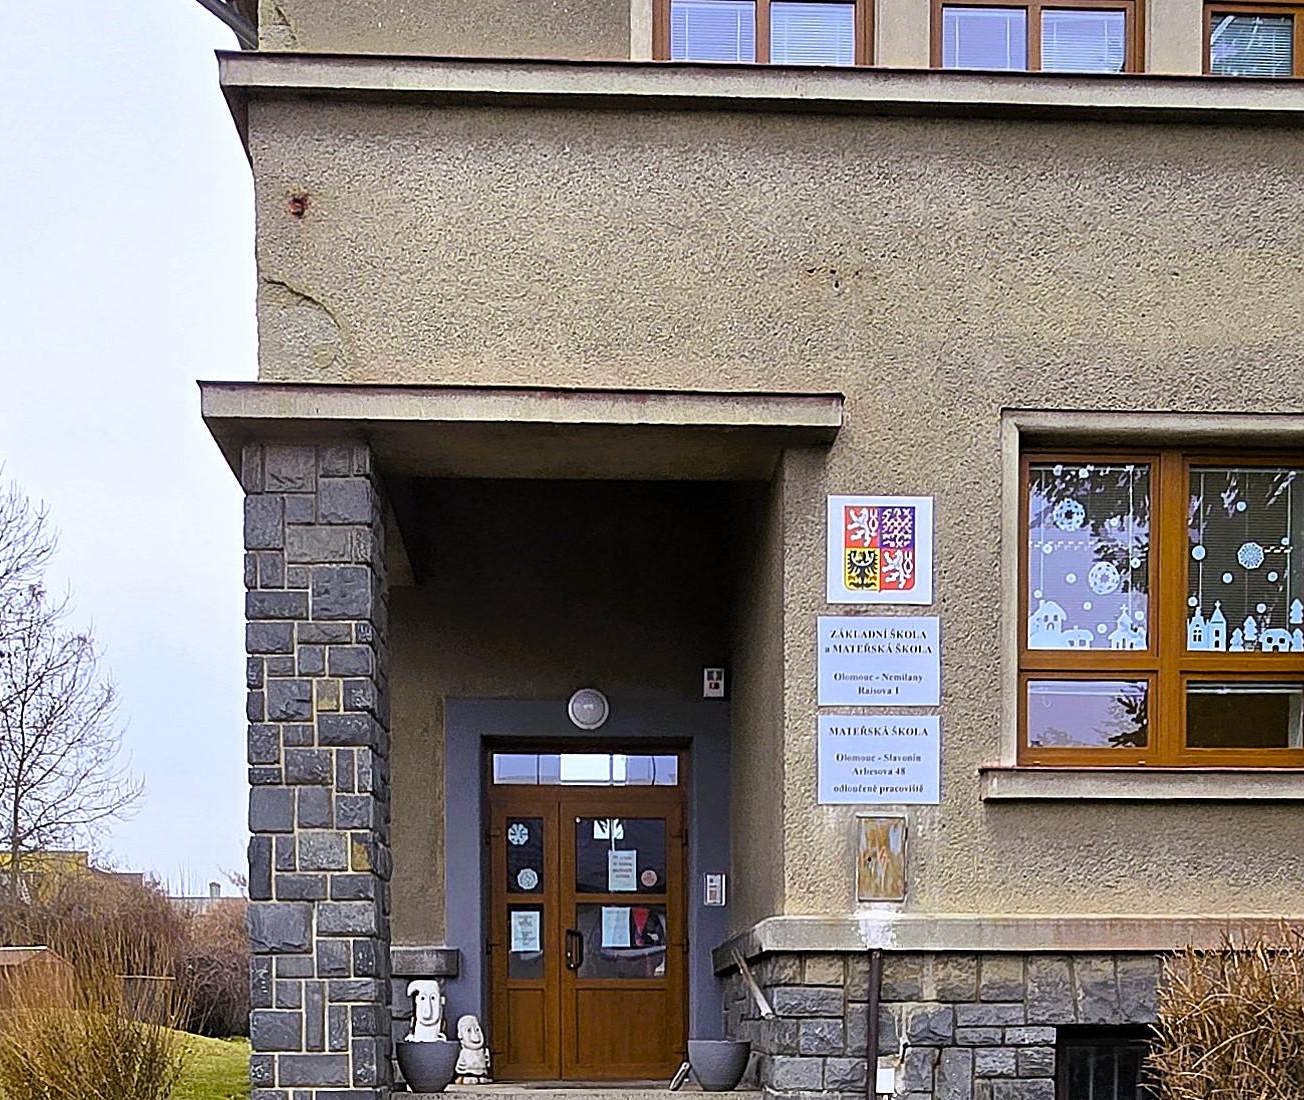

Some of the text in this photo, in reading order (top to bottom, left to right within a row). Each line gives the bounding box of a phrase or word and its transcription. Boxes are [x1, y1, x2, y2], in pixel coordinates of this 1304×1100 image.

[830, 628, 926, 639] ZÁKLADNÍ ŠKOLA
[833, 642, 893, 653] MATEŘSKÁ
[896, 643, 932, 653] ŠKOLA
[834, 673, 873, 681] Olomouc
[882, 673, 922, 683] Nemilany
[829, 726, 928, 736] MATEŘSKÁ ŠKOLA
[836, 753, 875, 762] Olomouc
